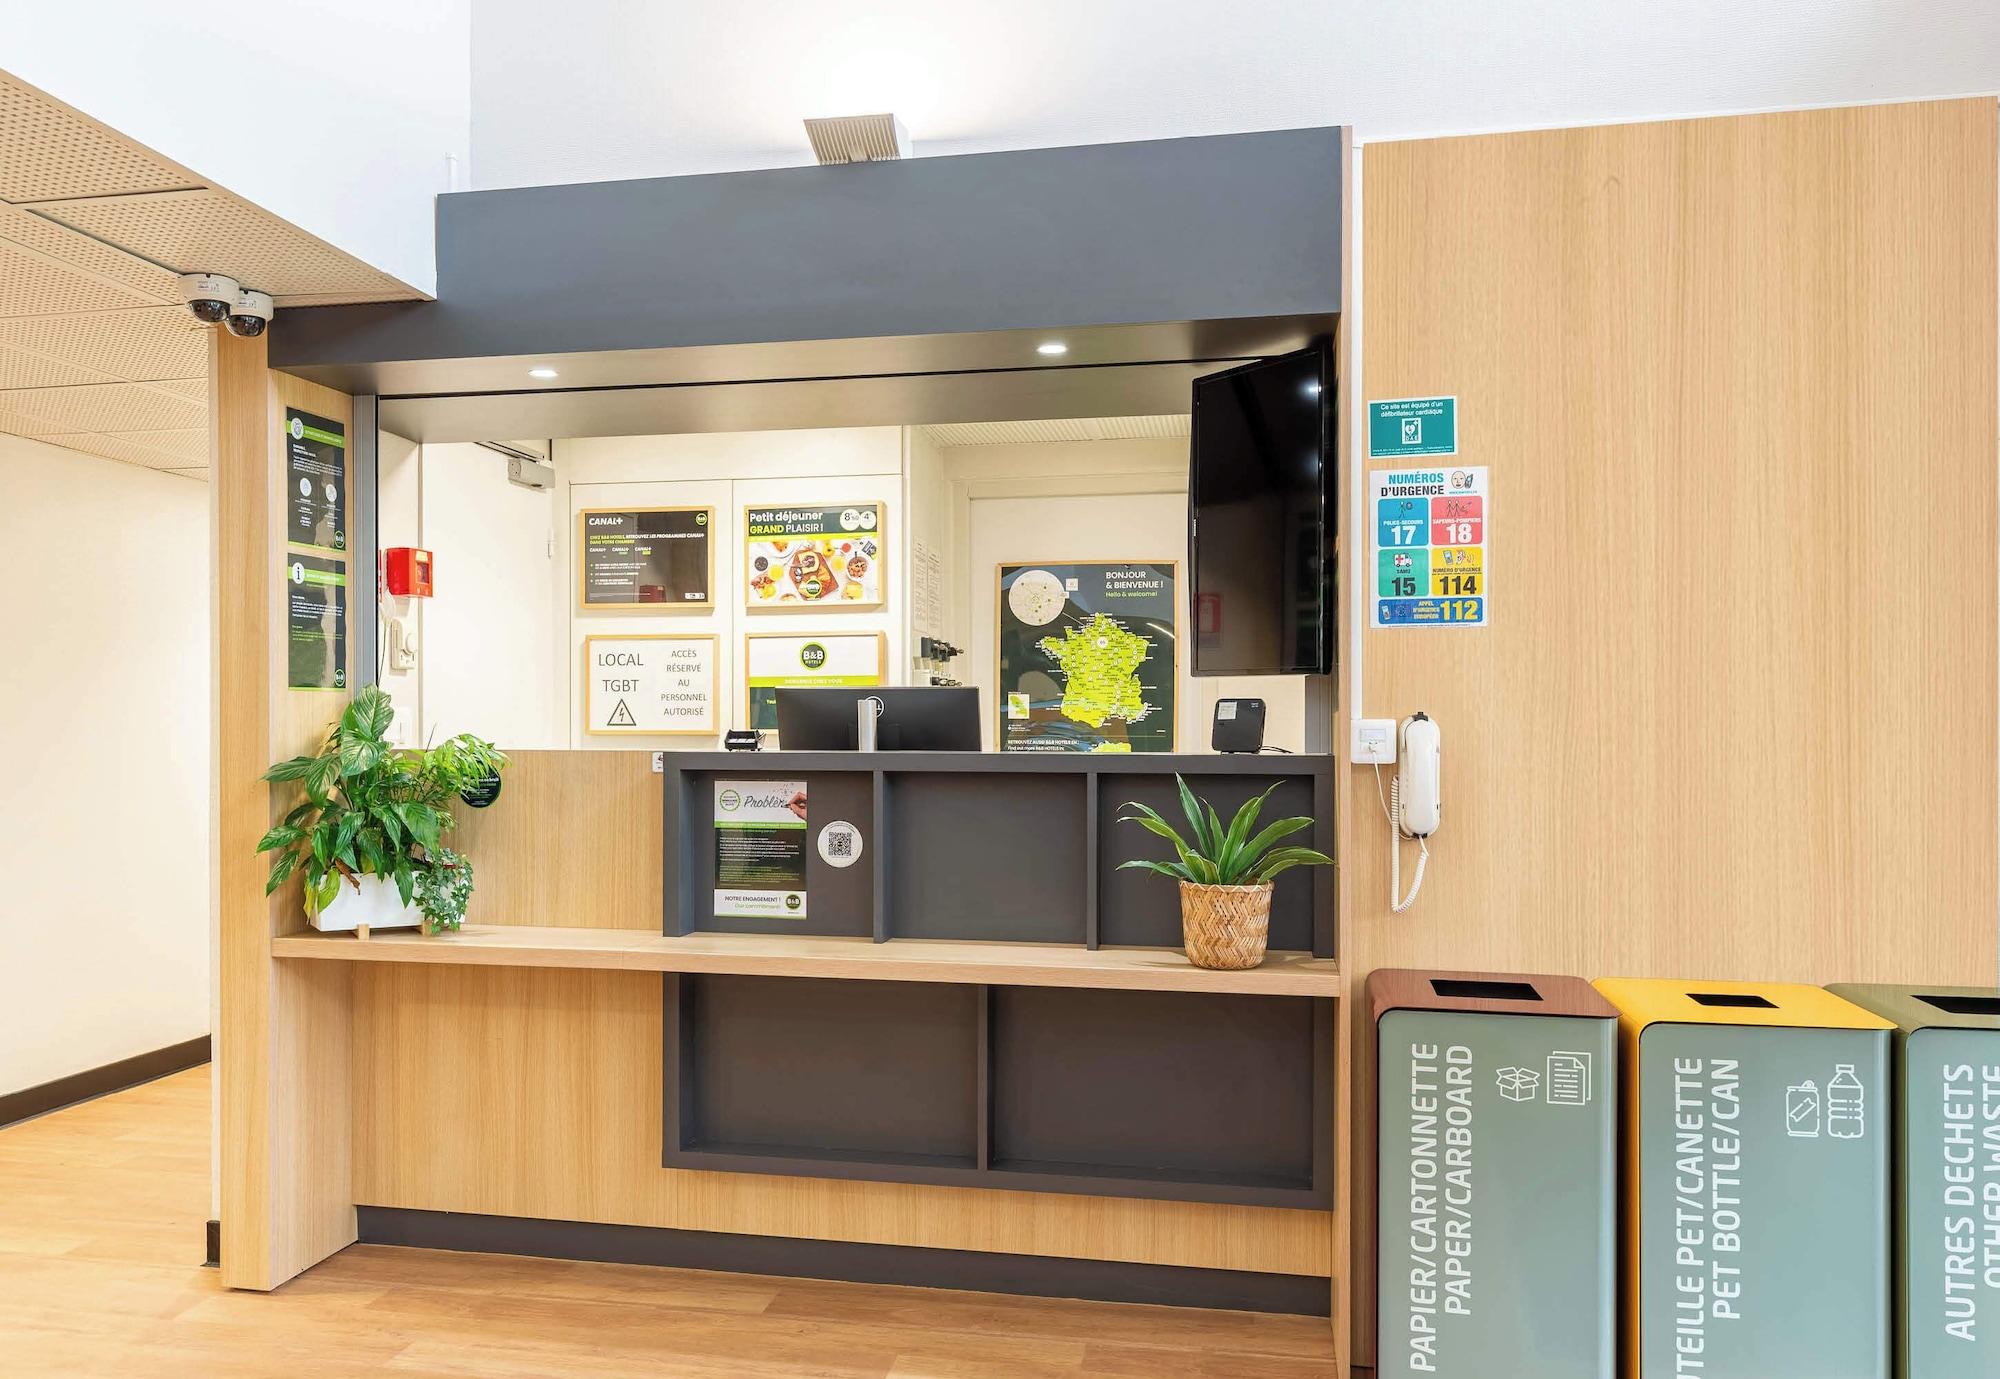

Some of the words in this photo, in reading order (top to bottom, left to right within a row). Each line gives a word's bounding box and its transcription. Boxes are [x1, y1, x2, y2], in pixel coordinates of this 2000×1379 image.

[1411, 402, 1429, 410] équipé
[1388, 471, 1444, 484] NUMÉROS
[1381, 485, 1444, 496] D'URGENCE
[588, 517, 623, 526] CANAL+
[750, 512, 774, 522] Petit
[775, 510, 823, 524] déjeuner
[750, 524, 784, 534] GRAND
[786, 524, 820, 532] PLAISIR
[1391, 526, 1416, 544] 17
[1446, 524, 1472, 544] 18
[1106, 571, 1146, 579] BONJOUR
[1392, 577, 1416, 596] 15
[1440, 576, 1477, 595] 114
[1440, 600, 1478, 620] 112
[598, 654, 644, 666] LOCAL
[671, 649, 697, 658] ACCÈS
[803, 650, 824, 660] B&B
[666, 664, 701, 672] RÉSERVÉ
[602, 680, 639, 692] TGBT
[664, 707, 704, 715] AUTORISÉ
[1943, 1064, 1975, 1205] DECHETS
[1674, 1058, 1704, 1266] PET/CANETTE
[1711, 1059, 1740, 1251] BOTTLE/CAN
[1445, 1045, 1472, 1314] PAPER/CARBOARD
[1410, 1043, 1438, 1372] PAPIER/CARTONNETTE
[1944, 1216, 1976, 1341] AUTRES
[1712, 1261, 1740, 1319] PET
